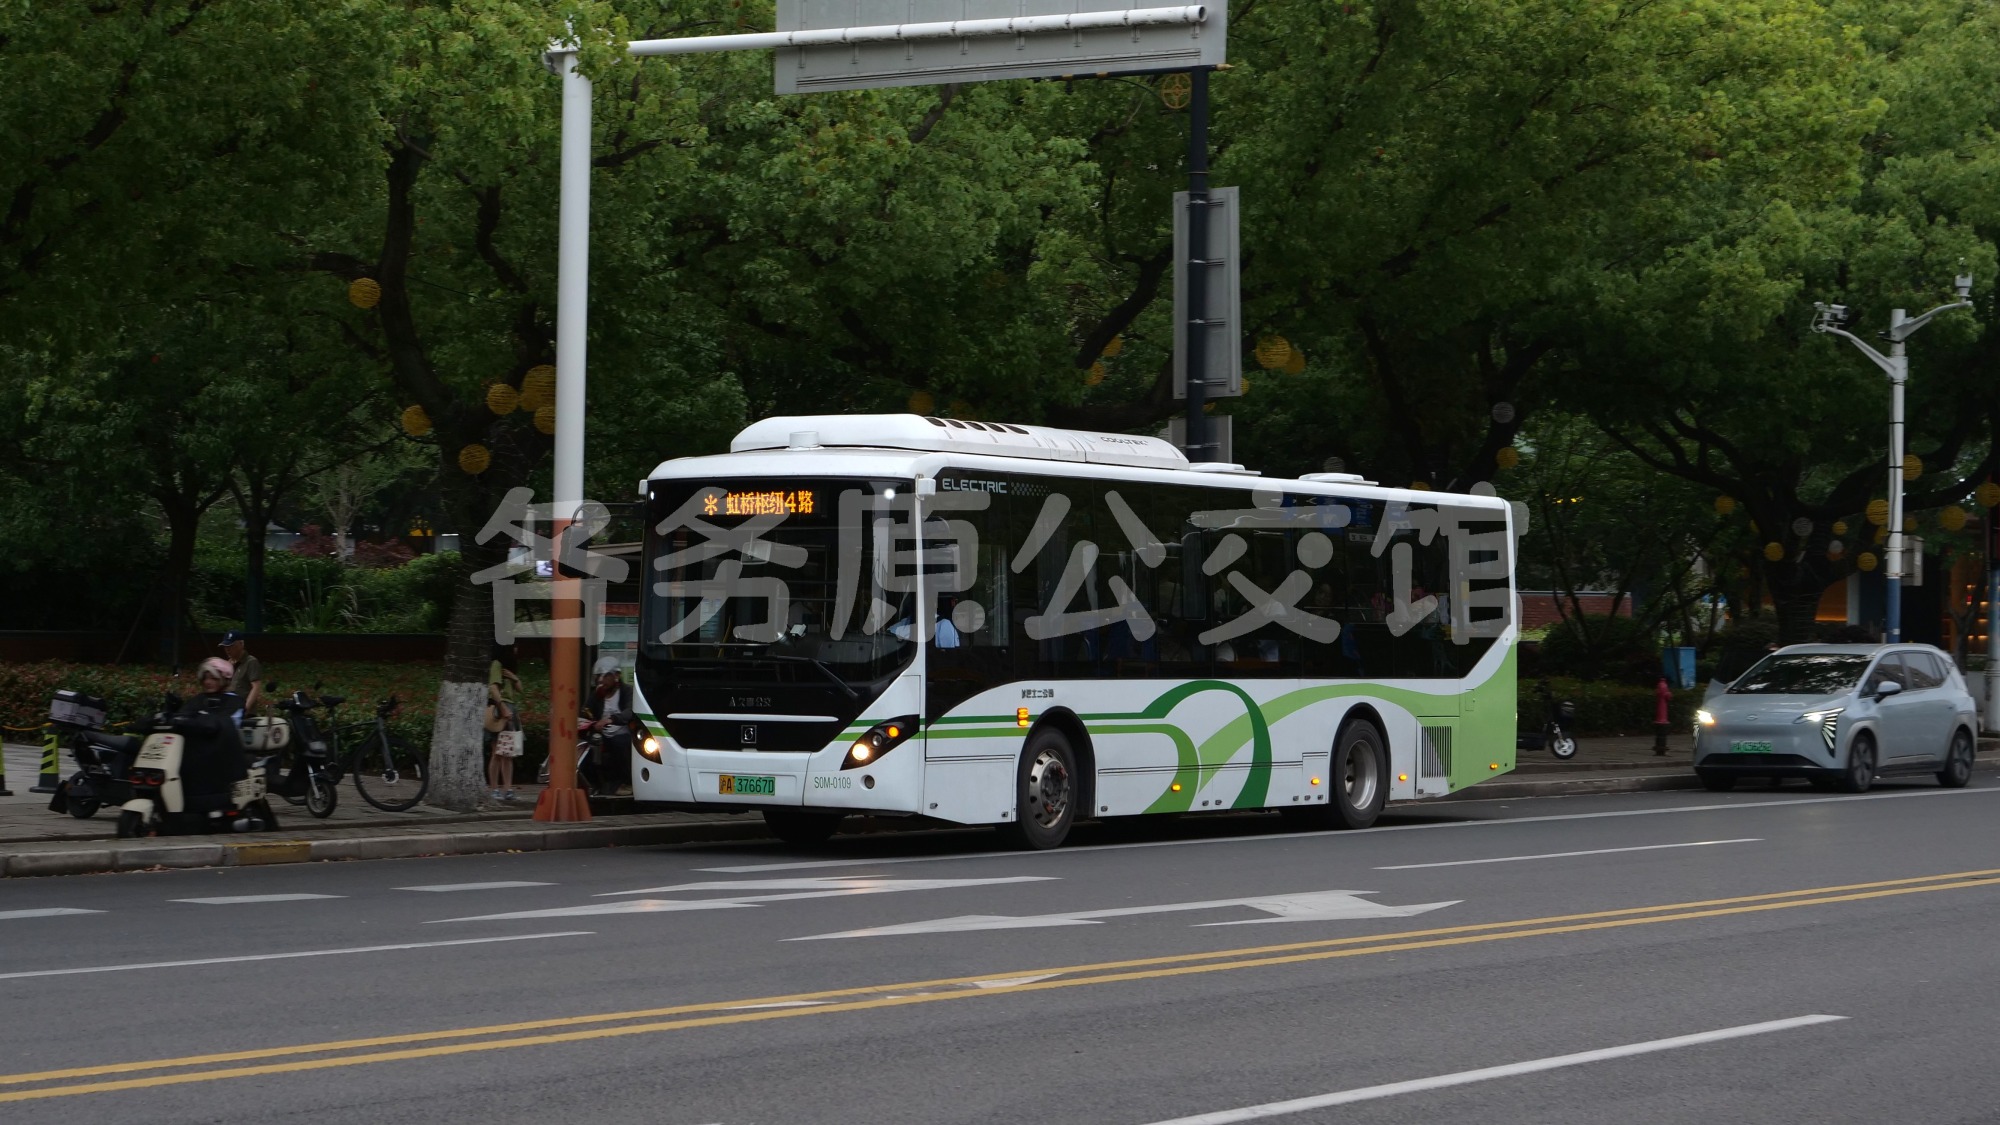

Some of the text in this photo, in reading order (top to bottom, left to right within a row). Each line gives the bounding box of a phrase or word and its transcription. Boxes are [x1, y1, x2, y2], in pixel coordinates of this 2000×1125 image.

[942, 477, 1007, 494] ELECTRIC
[726, 490, 814, 515] 虹桥枢纽4路
